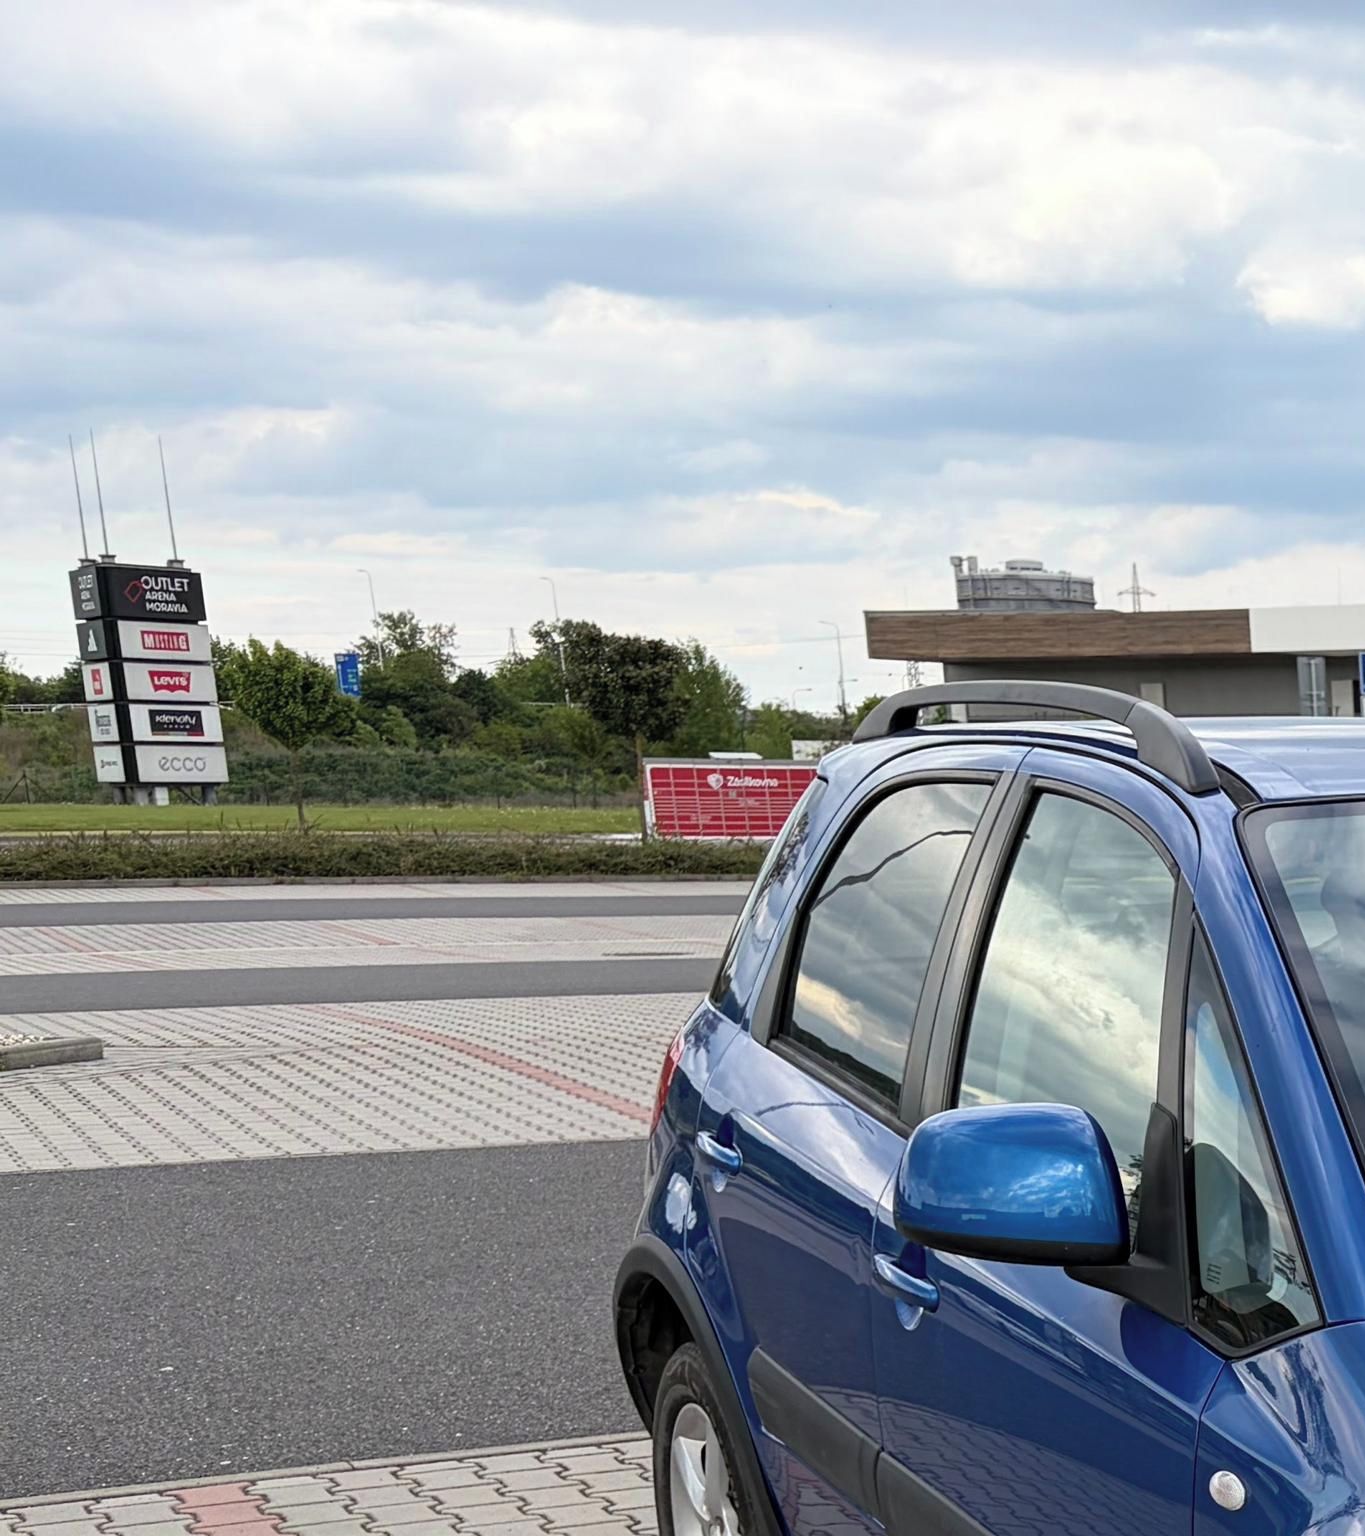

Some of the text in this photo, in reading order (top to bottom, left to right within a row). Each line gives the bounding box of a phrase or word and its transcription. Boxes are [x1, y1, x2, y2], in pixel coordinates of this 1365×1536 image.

[140, 575, 189, 592] OUTLET
[145, 591, 177, 601] ARENA
[145, 601, 189, 613] MORAVIA
[158, 757, 207, 772] ecco
